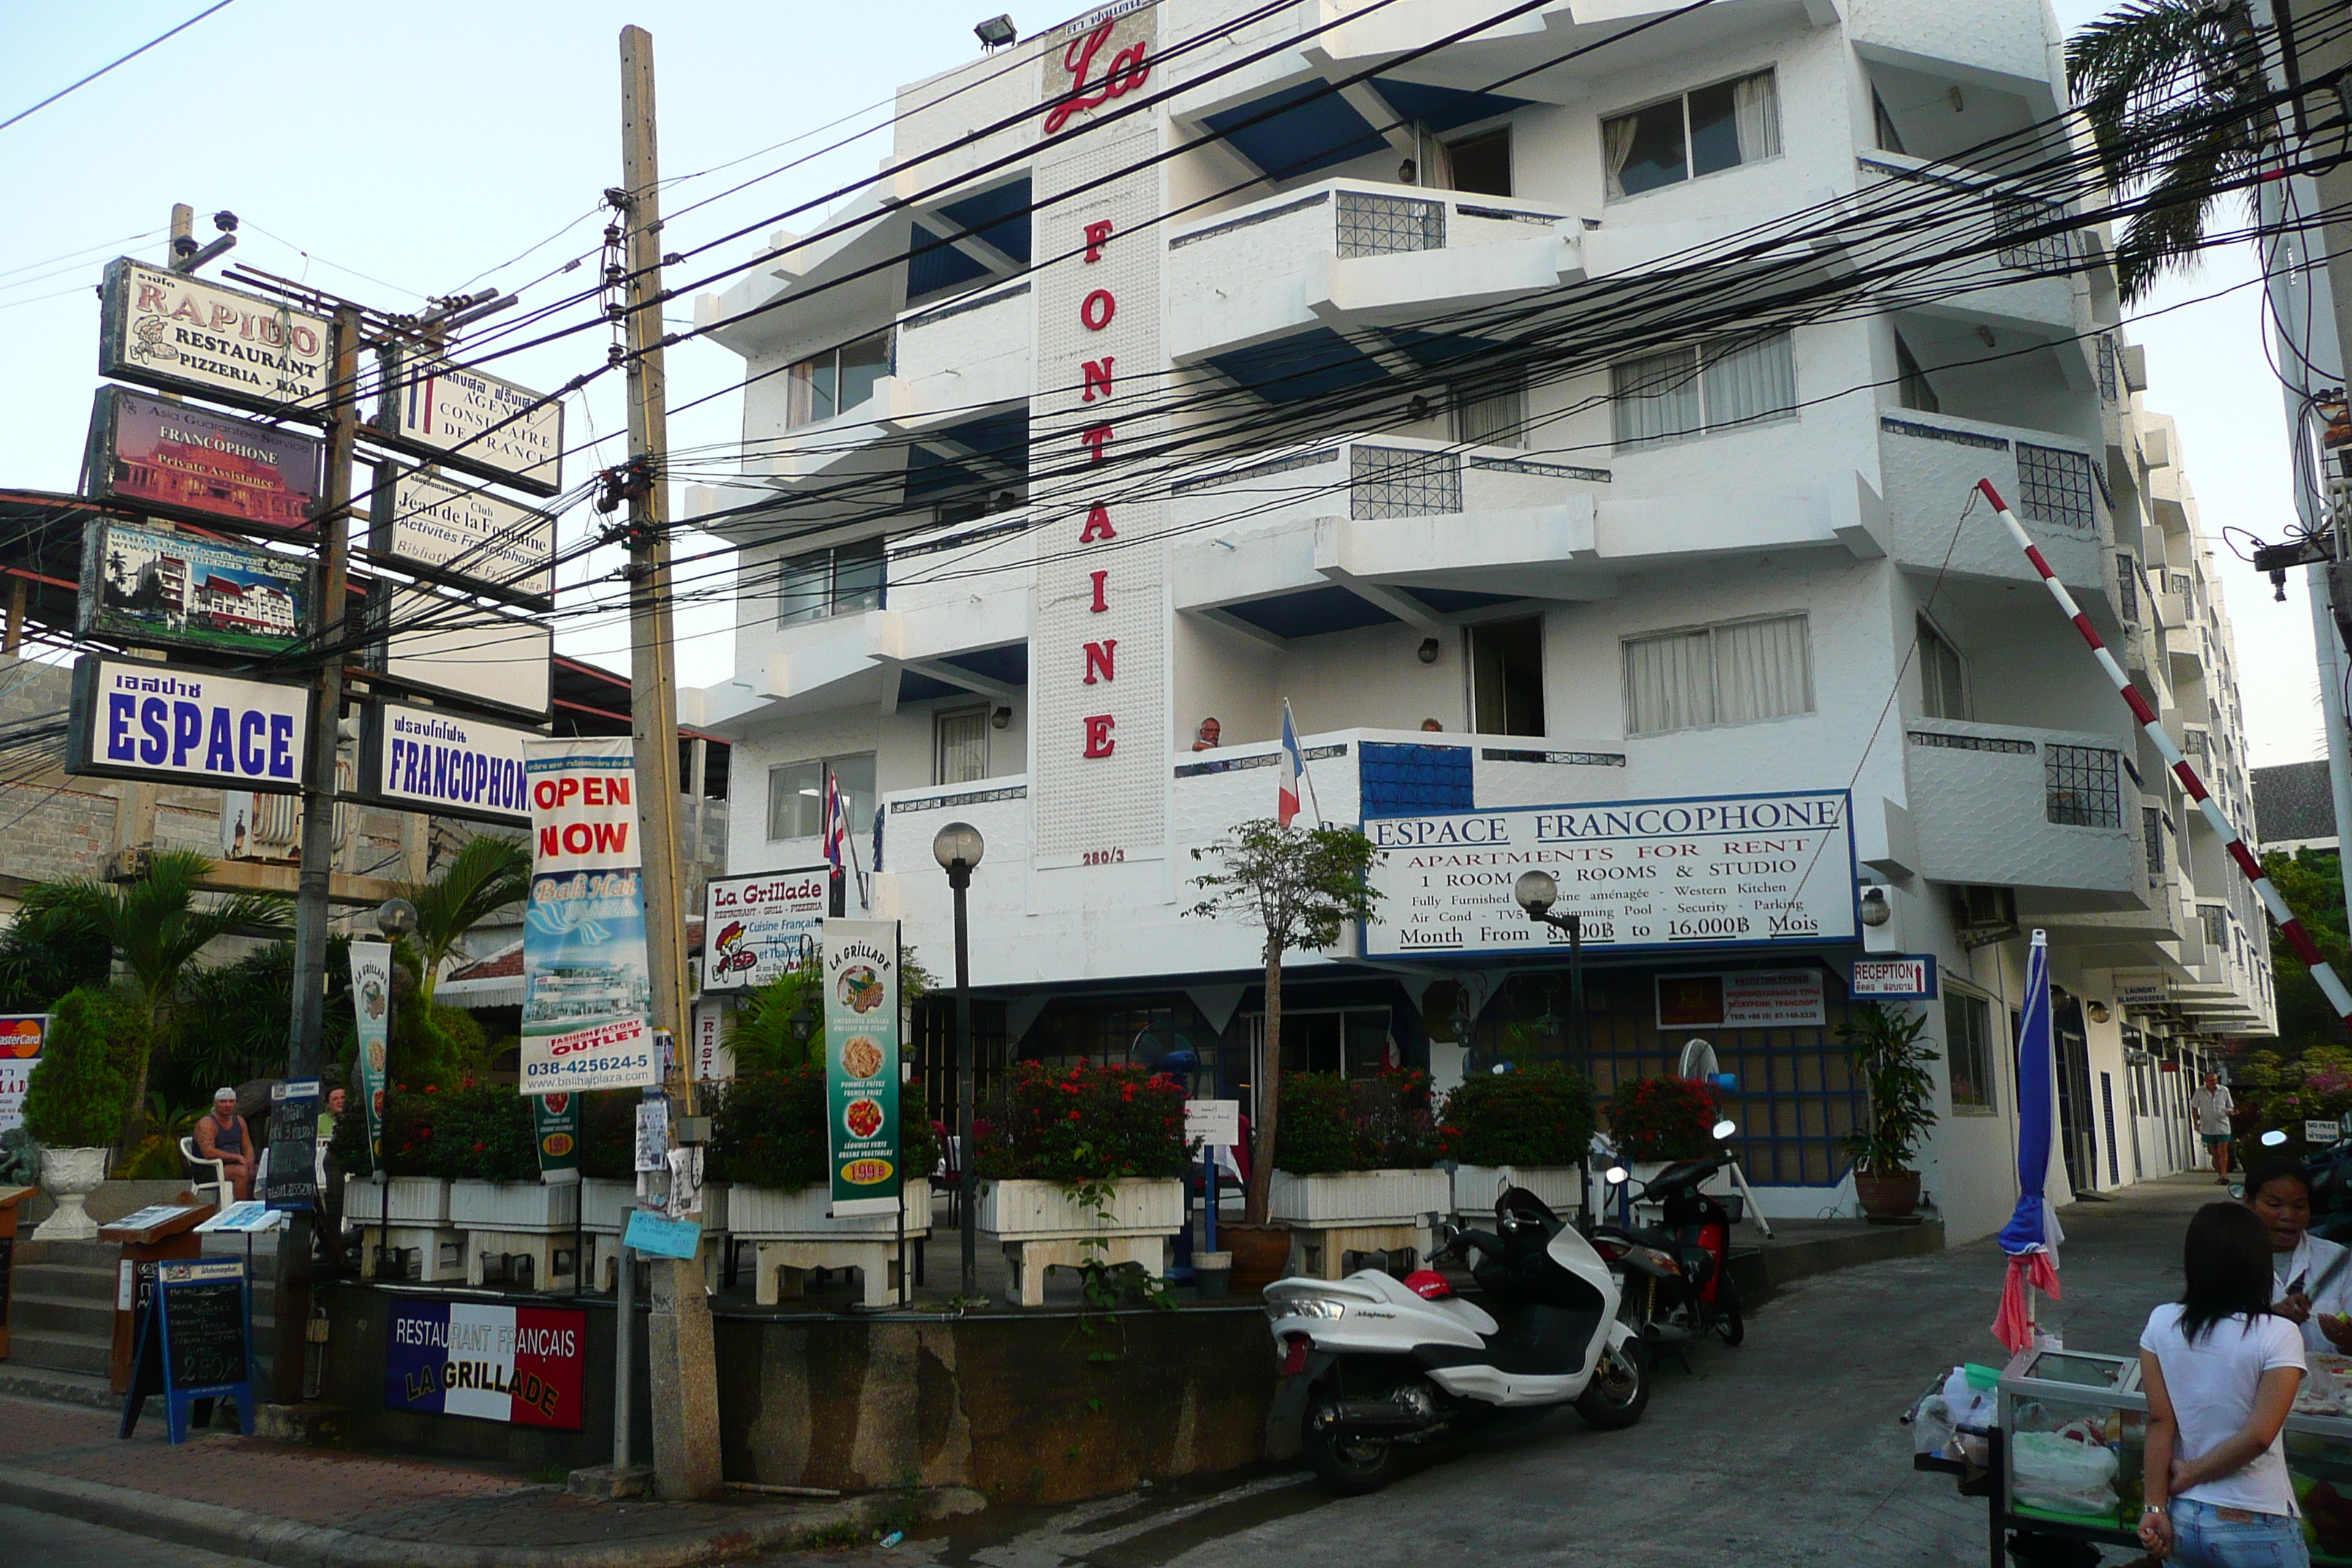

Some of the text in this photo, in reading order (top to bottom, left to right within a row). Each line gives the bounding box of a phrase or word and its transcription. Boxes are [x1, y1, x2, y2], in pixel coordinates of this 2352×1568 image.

[1044, 16, 1151, 134] La
[136, 282, 320, 357] RAPIDO
[175, 328, 317, 378] RESTAURANT
[179, 353, 312, 398] PIZZERIA BAR
[149, 406, 309, 453] Asia Guarantee Service
[445, 423, 466, 440] DE
[160, 426, 279, 465] FRANCOPHONE
[158, 453, 274, 488] Private Assistance
[399, 491, 437, 517] Jean
[442, 505, 461, 524] de
[465, 511, 478, 529] la
[470, 502, 493, 517] Club
[399, 518, 458, 543] Activités
[110, 541, 158, 554] WIWAT
[165, 551, 243, 570] RESIDENCE
[108, 692, 293, 779] ESPACE
[389, 738, 531, 811] FRANCOPHON
[534, 777, 630, 810] OPEN
[1376, 801, 1839, 845] ESPACE FRANCOPHONE
[538, 822, 628, 859] NOW
[1407, 839, 1810, 868] APARTMENTS FOR RENT
[1083, 846, 1125, 866] 280/3
[1422, 859, 1797, 887] 1 ROOM 2 ROOMS & STUDIO
[534, 873, 638, 901] Bali Hai
[715, 879, 821, 907] La Grillade
[1411, 882, 1787, 909] Fully Furnished sine aménagée Western Kitchen
[715, 902, 823, 919] RESTAURANT GRILL PIZZERIA
[1411, 899, 1804, 924] Air Cond TV5 Swimming Pool Security Parking
[749, 921, 779, 932] Cuisine
[766, 933, 801, 944] Italienn
[1400, 927, 1463, 944] Month
[1480, 927, 1530, 942] From
[1632, 924, 1650, 937] to
[1768, 913, 1818, 932] Mois
[759, 949, 768, 959] et
[771, 948, 788, 958] Thai
[829, 953, 842, 970] LA
[355, 971, 362, 985] LA
[1855, 963, 1913, 979] RECEPTION
[1725, 989, 1797, 998] ИНДИВИДУАЛЬНЫЕ
[1775, 999, 1818, 1007] ТРАНСПОРТ
[2117, 995, 2166, 1003] BLANCHISSERIE
[2125, 987, 2157, 995] LAUNDRY
[1762, 1012, 1772, 1020] (0)
[0, 1033, 40, 1045] asterCard
[551, 1019, 639, 1047] FASHION FACTORY
[552, 1028, 641, 1055] OUTLET
[527, 1055, 647, 1076] 038-425624-5
[527, 1071, 648, 1089] www.balihaiplaza.com
[861, 1149, 893, 1157] VEGETABLES
[396, 1318, 575, 1363] RESTAURANT FRANÇAIS
[405, 1360, 559, 1419] LA GRILLADE
